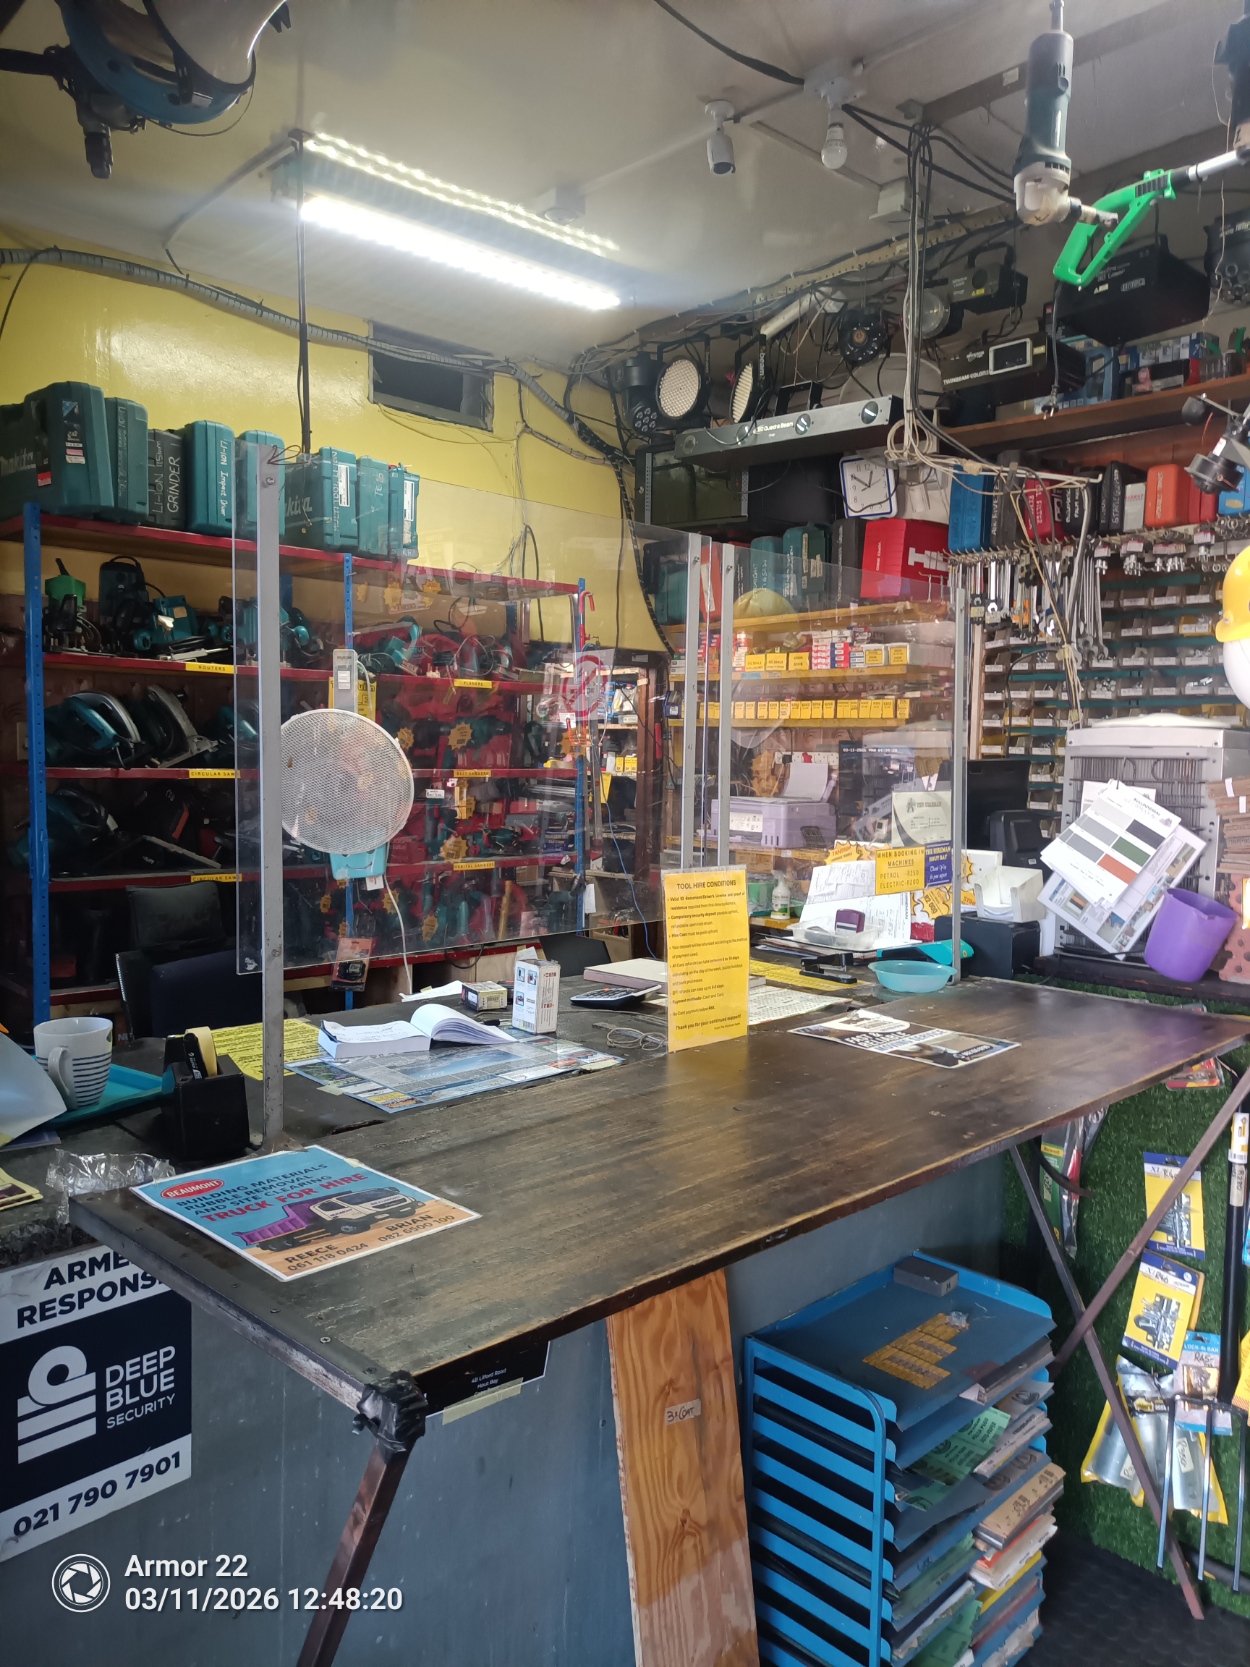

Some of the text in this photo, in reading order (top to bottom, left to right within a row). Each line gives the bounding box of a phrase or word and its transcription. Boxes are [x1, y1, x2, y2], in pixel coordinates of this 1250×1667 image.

[219, 440, 229, 467] LI-ION
[154, 468, 164, 514] LI-ION
[167, 456, 182, 514] GRINDER
[219, 470, 229, 500] Impact
[198, 664, 226, 672] ROUTERS
[934, 846, 951, 854] HIREMAN
[168, 1180, 219, 1198] BEAUMONT
[176, 1163, 328, 1207] BUILDING MATERIALS
[184, 1175, 313, 1211] RUBBLE REMOVAL
[194, 1175, 332, 1216] AND SITE CLEARING
[201, 1173, 368, 1222] TRUCK FOR HIRE
[378, 1231, 402, 1242] 082
[404, 1222, 433, 1234] 6500
[385, 1214, 433, 1231] BRIAN
[44, 1251, 134, 1291] ARME
[284, 1244, 339, 1263] REECE
[287, 1243, 369, 1271] 061 118 0424
[17, 1272, 166, 1329] RESPONS
[105, 1345, 176, 1389] DEEP
[494, 1367, 507, 1378] Road
[106, 1367, 175, 1412] BLUE
[107, 1393, 176, 1429] SECURITY
[13, 1450, 181, 1537] 021 790 7901
